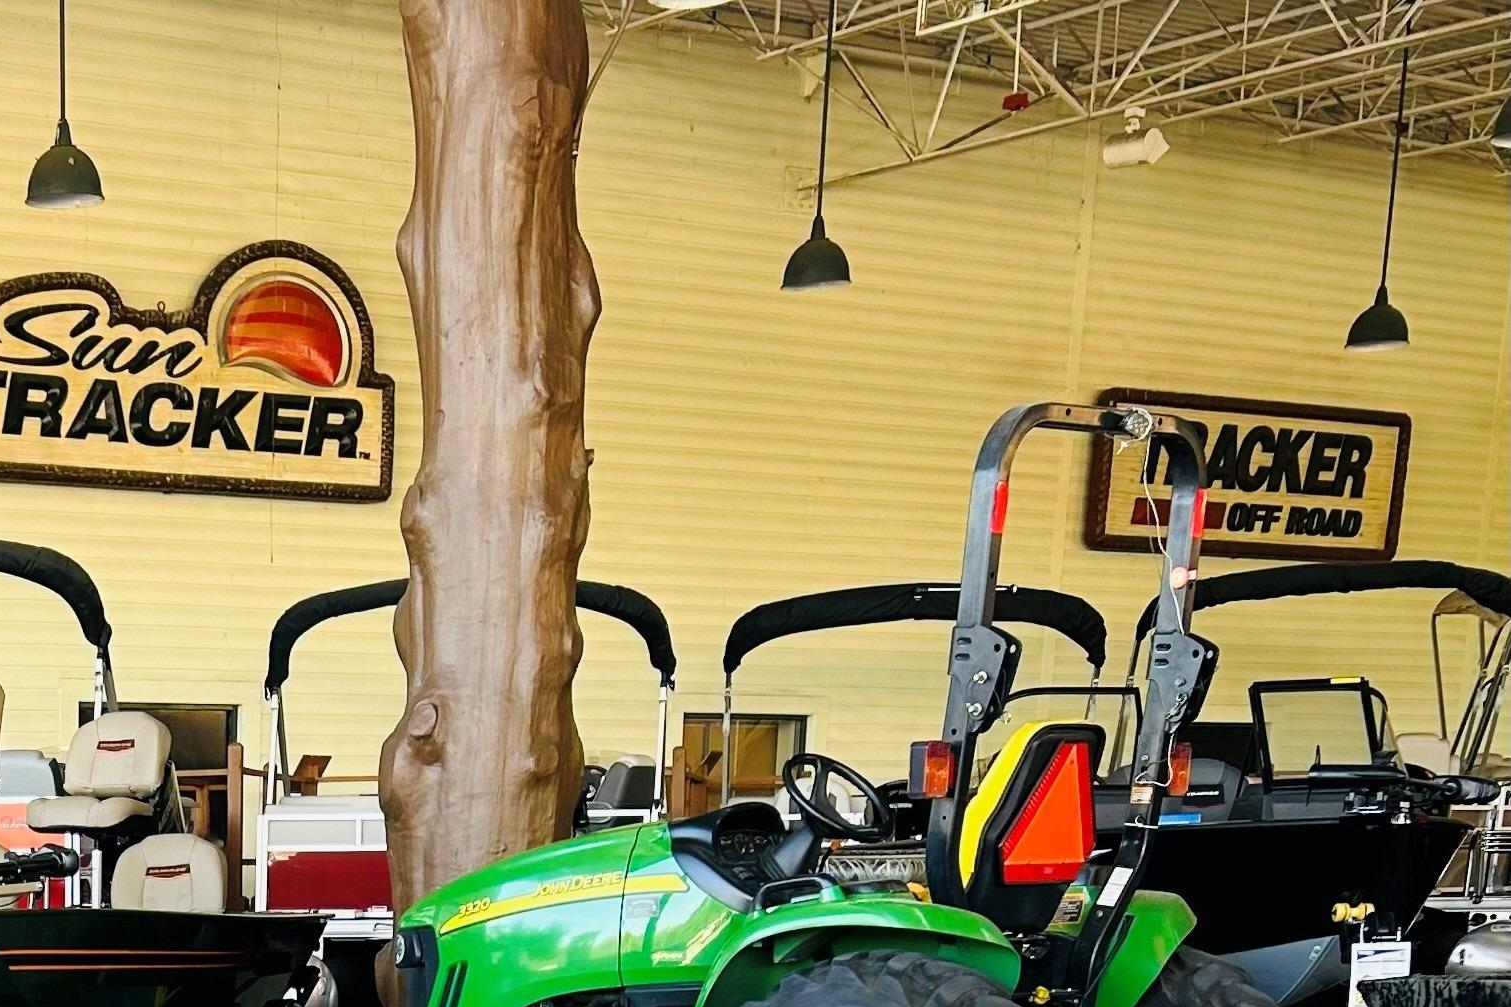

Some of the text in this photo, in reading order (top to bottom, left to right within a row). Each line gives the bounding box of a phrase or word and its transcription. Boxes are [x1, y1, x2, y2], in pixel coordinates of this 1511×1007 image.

[1140, 419, 1373, 498] ACKER
[1226, 502, 1362, 538] OFF ROAD
[534, 871, 623, 898] JOHN DEERE
[457, 896, 491, 919] 3320
